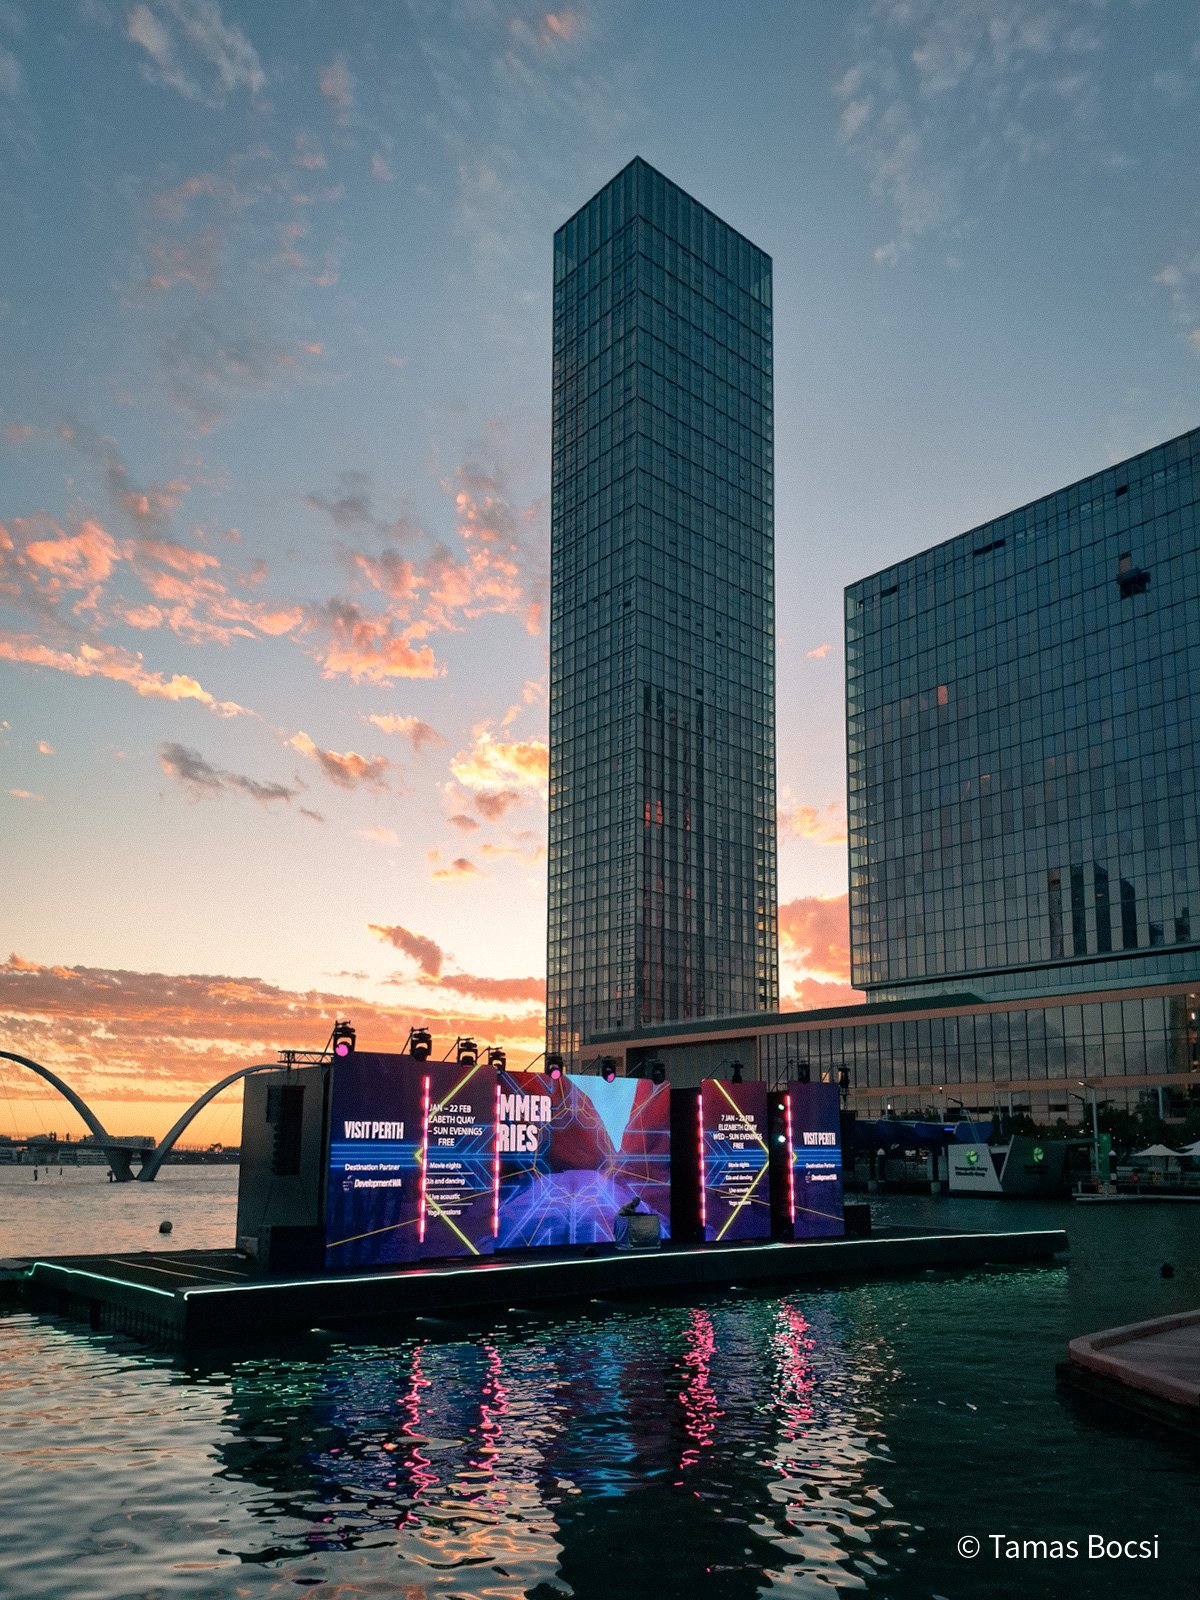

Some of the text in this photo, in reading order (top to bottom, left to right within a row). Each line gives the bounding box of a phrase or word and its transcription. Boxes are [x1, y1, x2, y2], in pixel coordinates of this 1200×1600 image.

[429, 1104, 443, 1112] JAN
[449, 1105, 458, 1113] 22
[459, 1105, 472, 1113] FEB
[500, 1094, 552, 1122] MMER
[456, 1116, 476, 1124] QUAY
[344, 1121, 404, 1139] VISIT PERTH
[433, 1127, 448, 1135] SUN
[449, 1127, 483, 1136] EVENINGS
[438, 1138, 455, 1146] FREE
[499, 1124, 538, 1152] RIES
[803, 1132, 836, 1145] VISIT PERTH
[344, 1163, 401, 1171] Destination Partner
